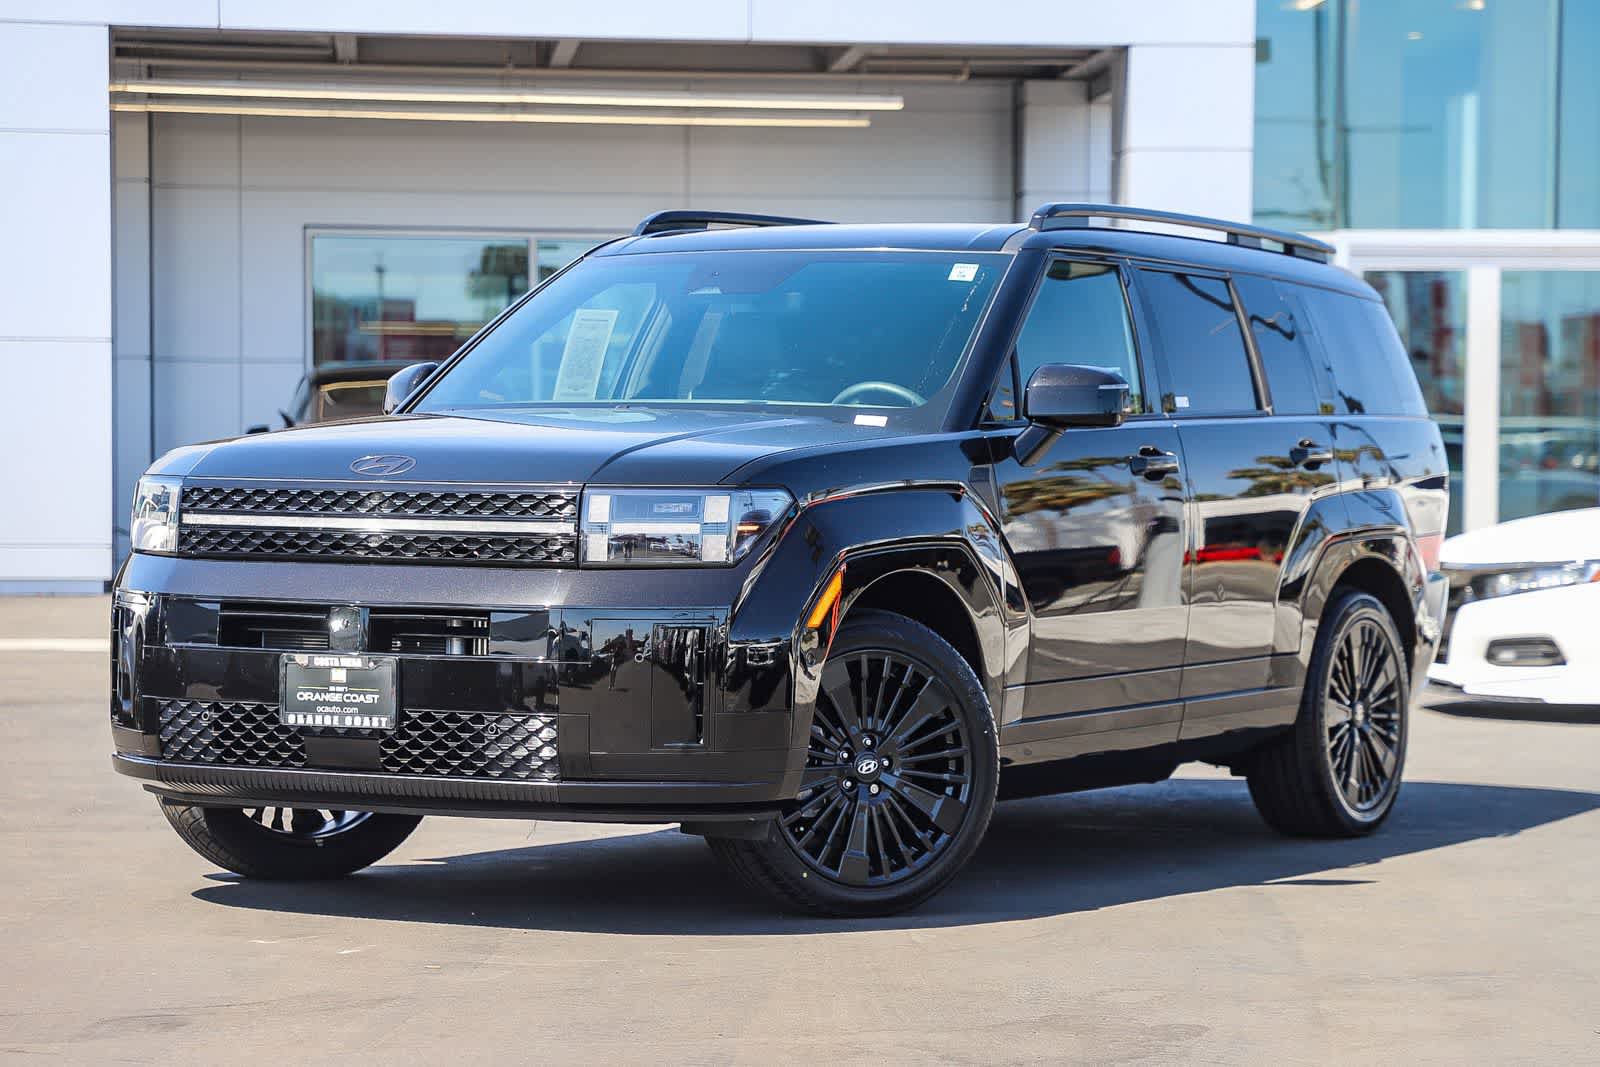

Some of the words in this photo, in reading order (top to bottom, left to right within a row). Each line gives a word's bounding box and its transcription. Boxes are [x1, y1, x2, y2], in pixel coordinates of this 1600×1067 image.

[296, 691, 343, 703] ORANGE
[343, 693, 380, 704] COAST
[316, 705, 359, 714] ocauto.com
